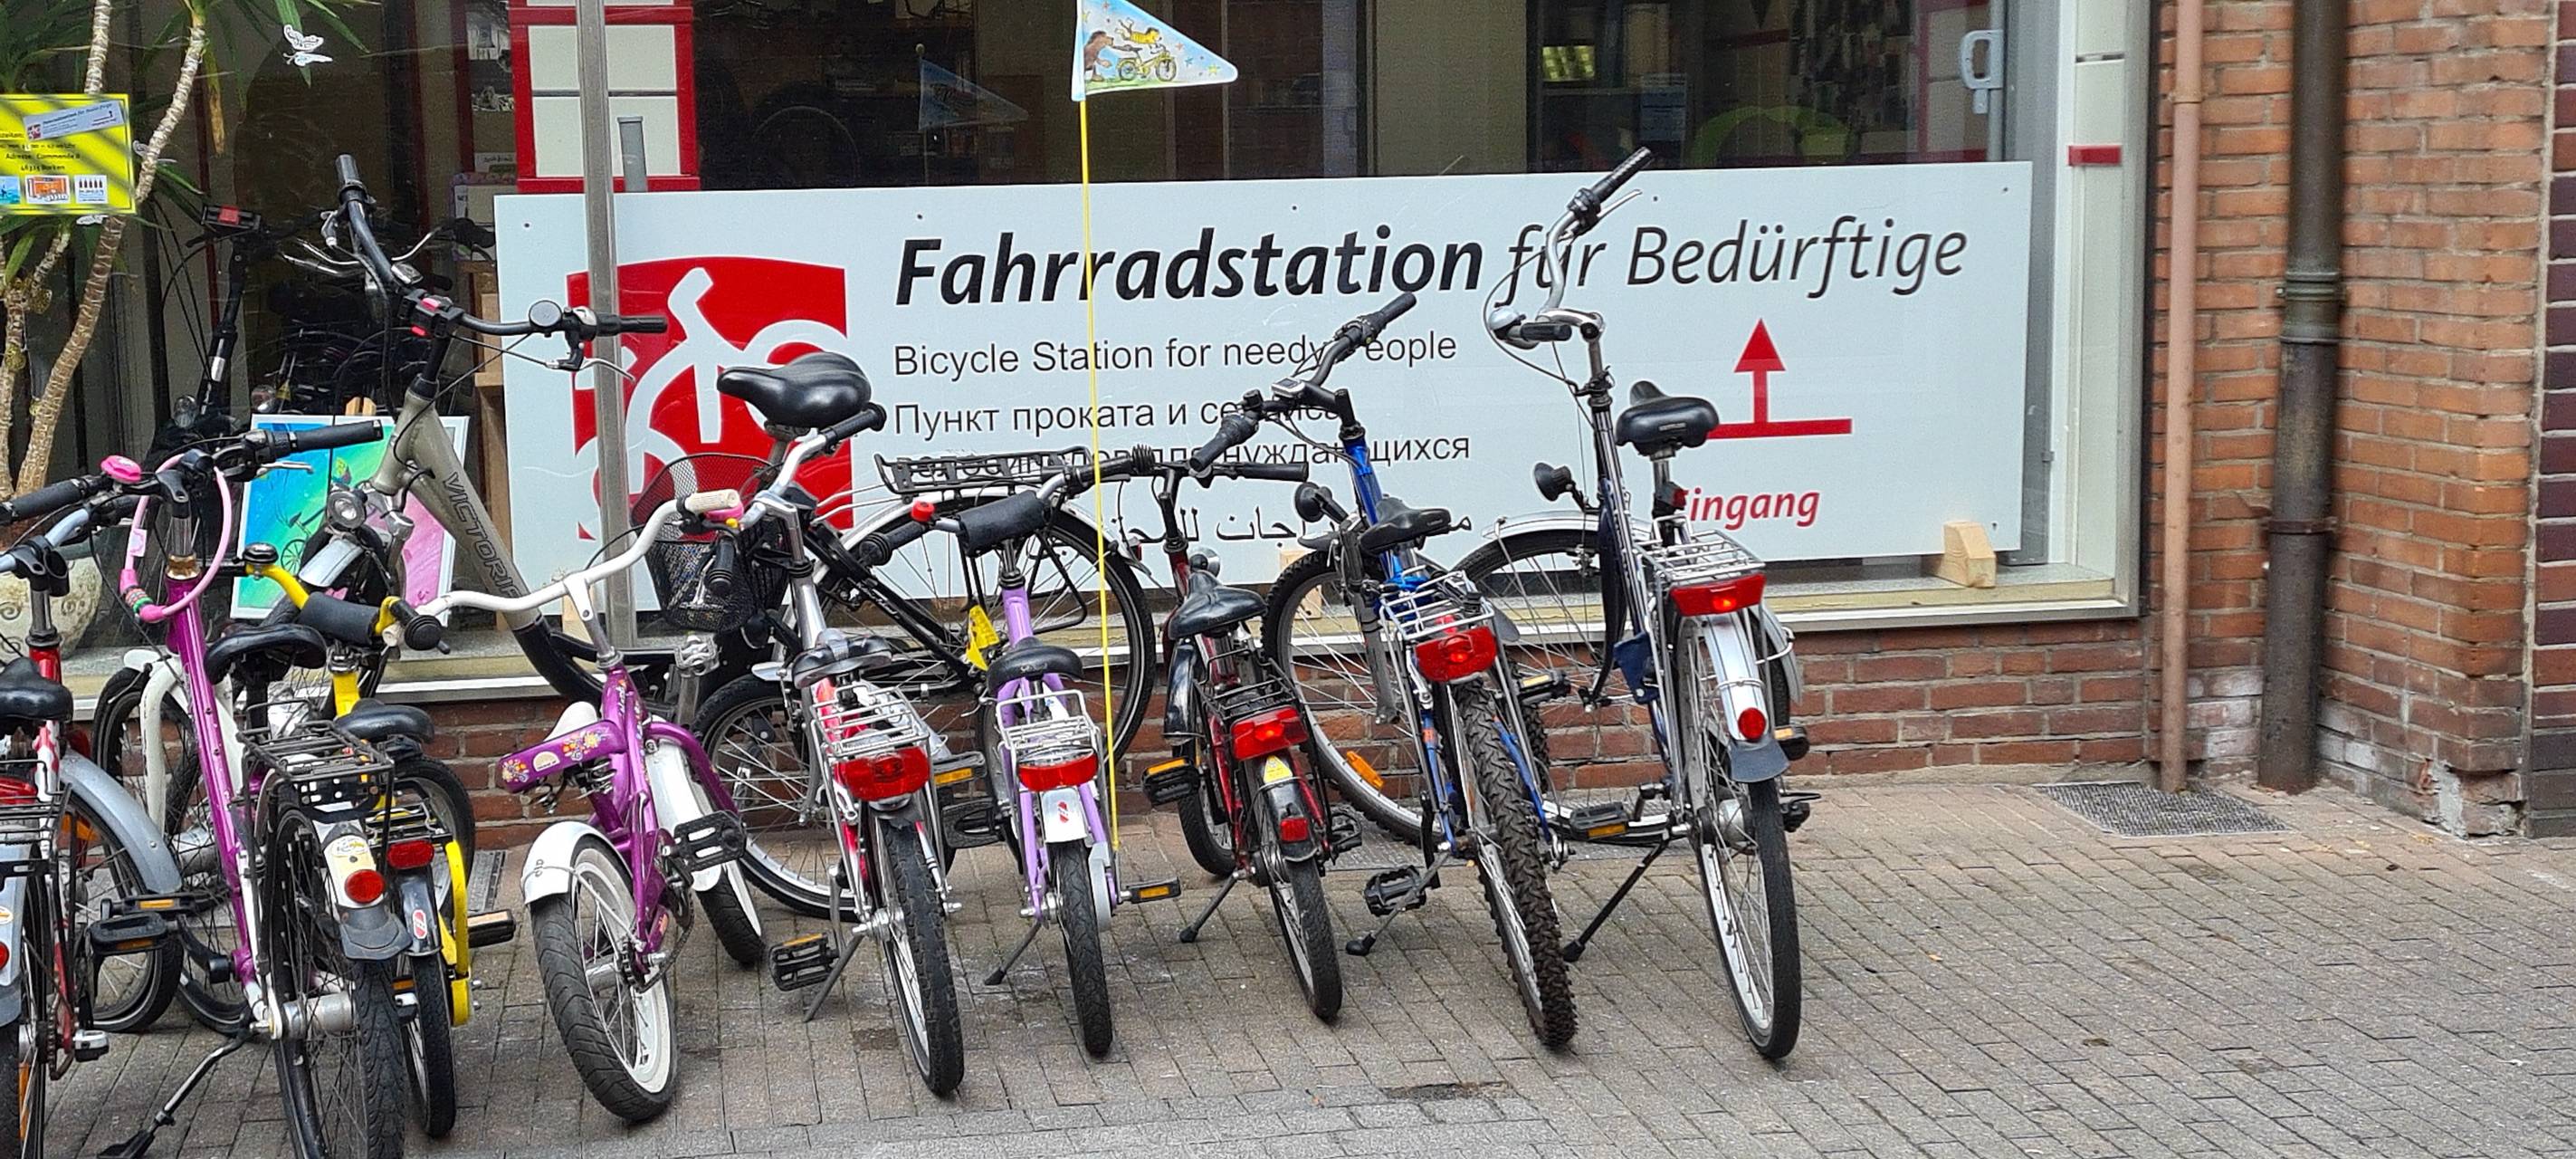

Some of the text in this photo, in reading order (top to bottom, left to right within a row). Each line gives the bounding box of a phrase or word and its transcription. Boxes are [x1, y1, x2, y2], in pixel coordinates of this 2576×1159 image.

[894, 225, 1483, 306] Fahrradstation
[1627, 216, 1968, 299] Bedürftige
[894, 330, 1457, 381] Bicycle Station for needy eople
[894, 403, 999, 441] Пункт
[1014, 399, 1155, 436] проката
[1168, 399, 1188, 426] и
[1685, 487, 1821, 531] ingang
